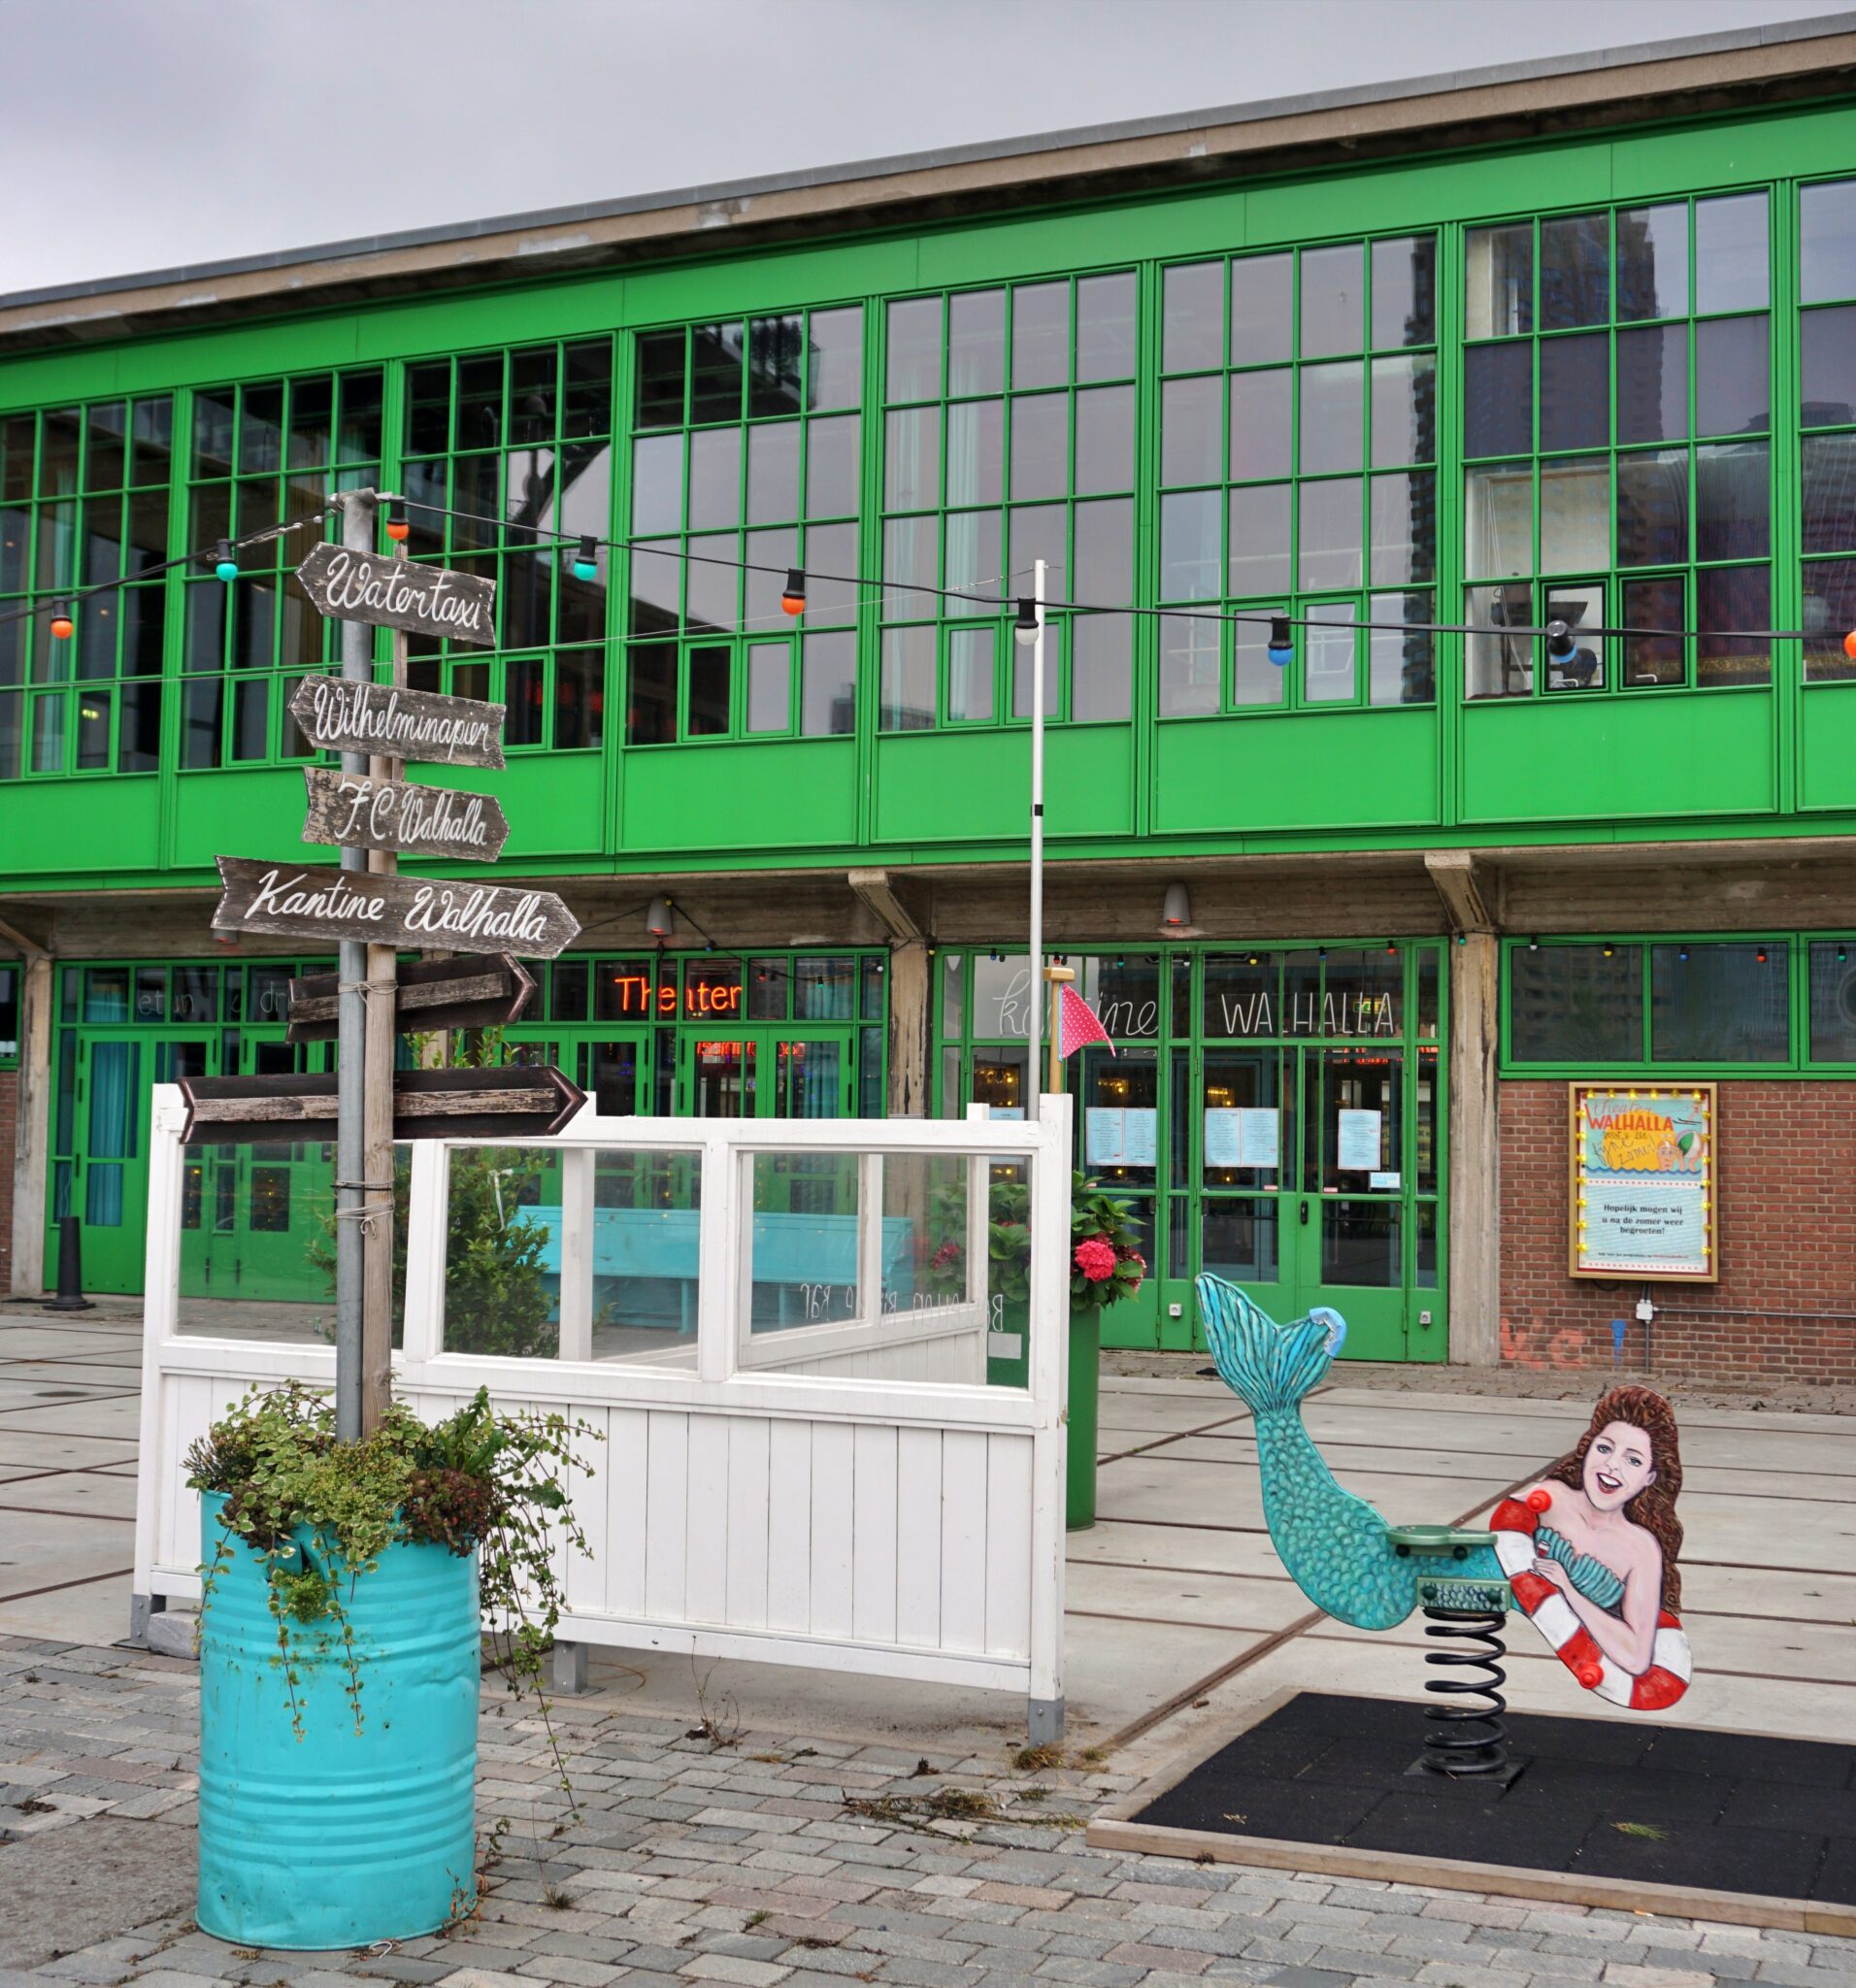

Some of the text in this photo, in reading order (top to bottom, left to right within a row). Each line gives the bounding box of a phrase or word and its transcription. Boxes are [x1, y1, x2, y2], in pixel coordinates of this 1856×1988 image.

[326, 551, 482, 630] Watertaxi
[314, 682, 490, 760] Wilhelminapier
[398, 788, 487, 846] Walhalla
[245, 869, 547, 943] Kantine Walhalla
[1221, 991, 1395, 1036] WAHALLA
[1584, 1103, 1674, 1132] WALHALLA
[1604, 1204, 1638, 1213] Hopelijk
[1670, 1206, 1683, 1215] wij
